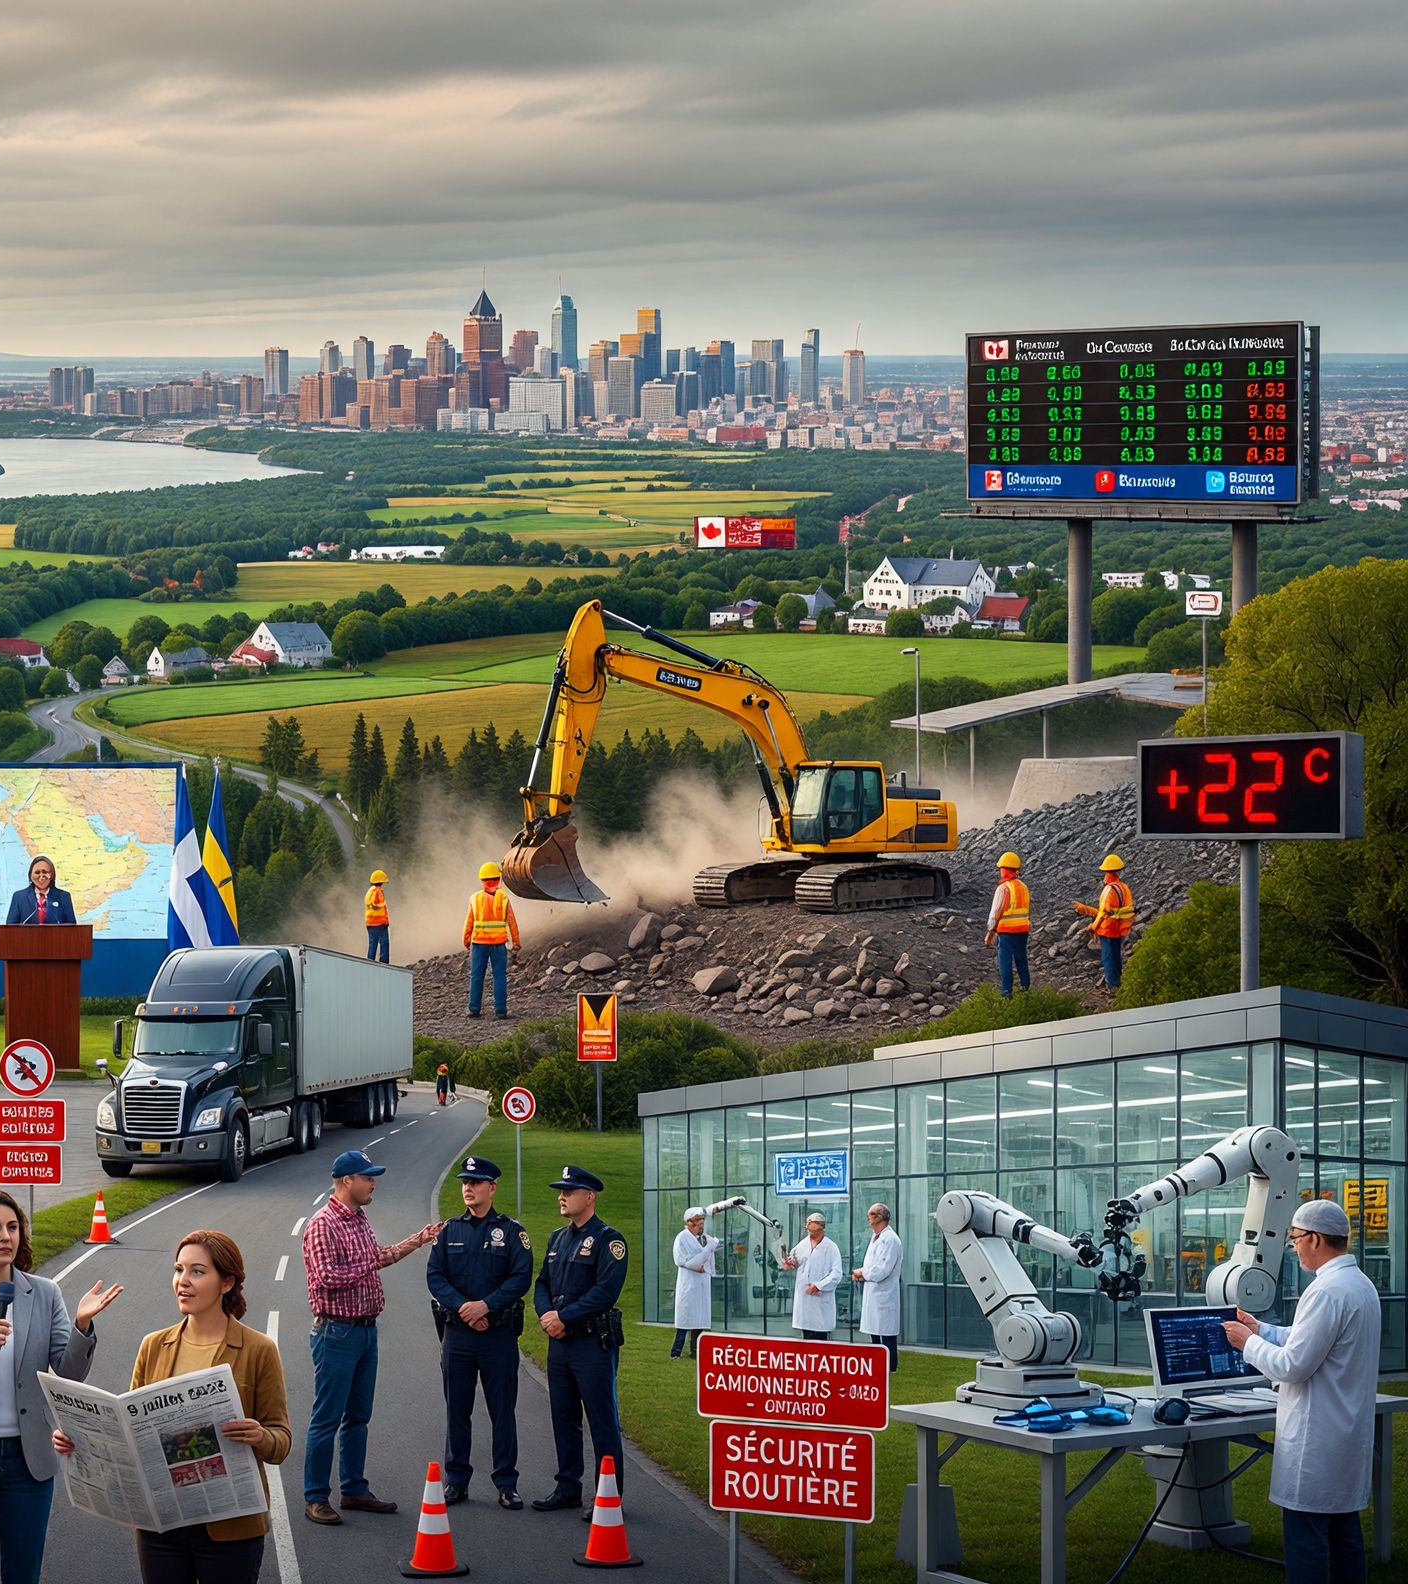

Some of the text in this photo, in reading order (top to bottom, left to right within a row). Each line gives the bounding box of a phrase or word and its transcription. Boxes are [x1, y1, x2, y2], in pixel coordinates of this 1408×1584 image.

[712, 1344, 873, 1377] RÉGLEMENTATION
[704, 1372, 831, 1399] CAMIONNEURS
[764, 1399, 826, 1417] ONTARIO
[725, 1430, 857, 1472] SÉCURITÉ
[724, 1470, 858, 1508] ROUTIÈRE
